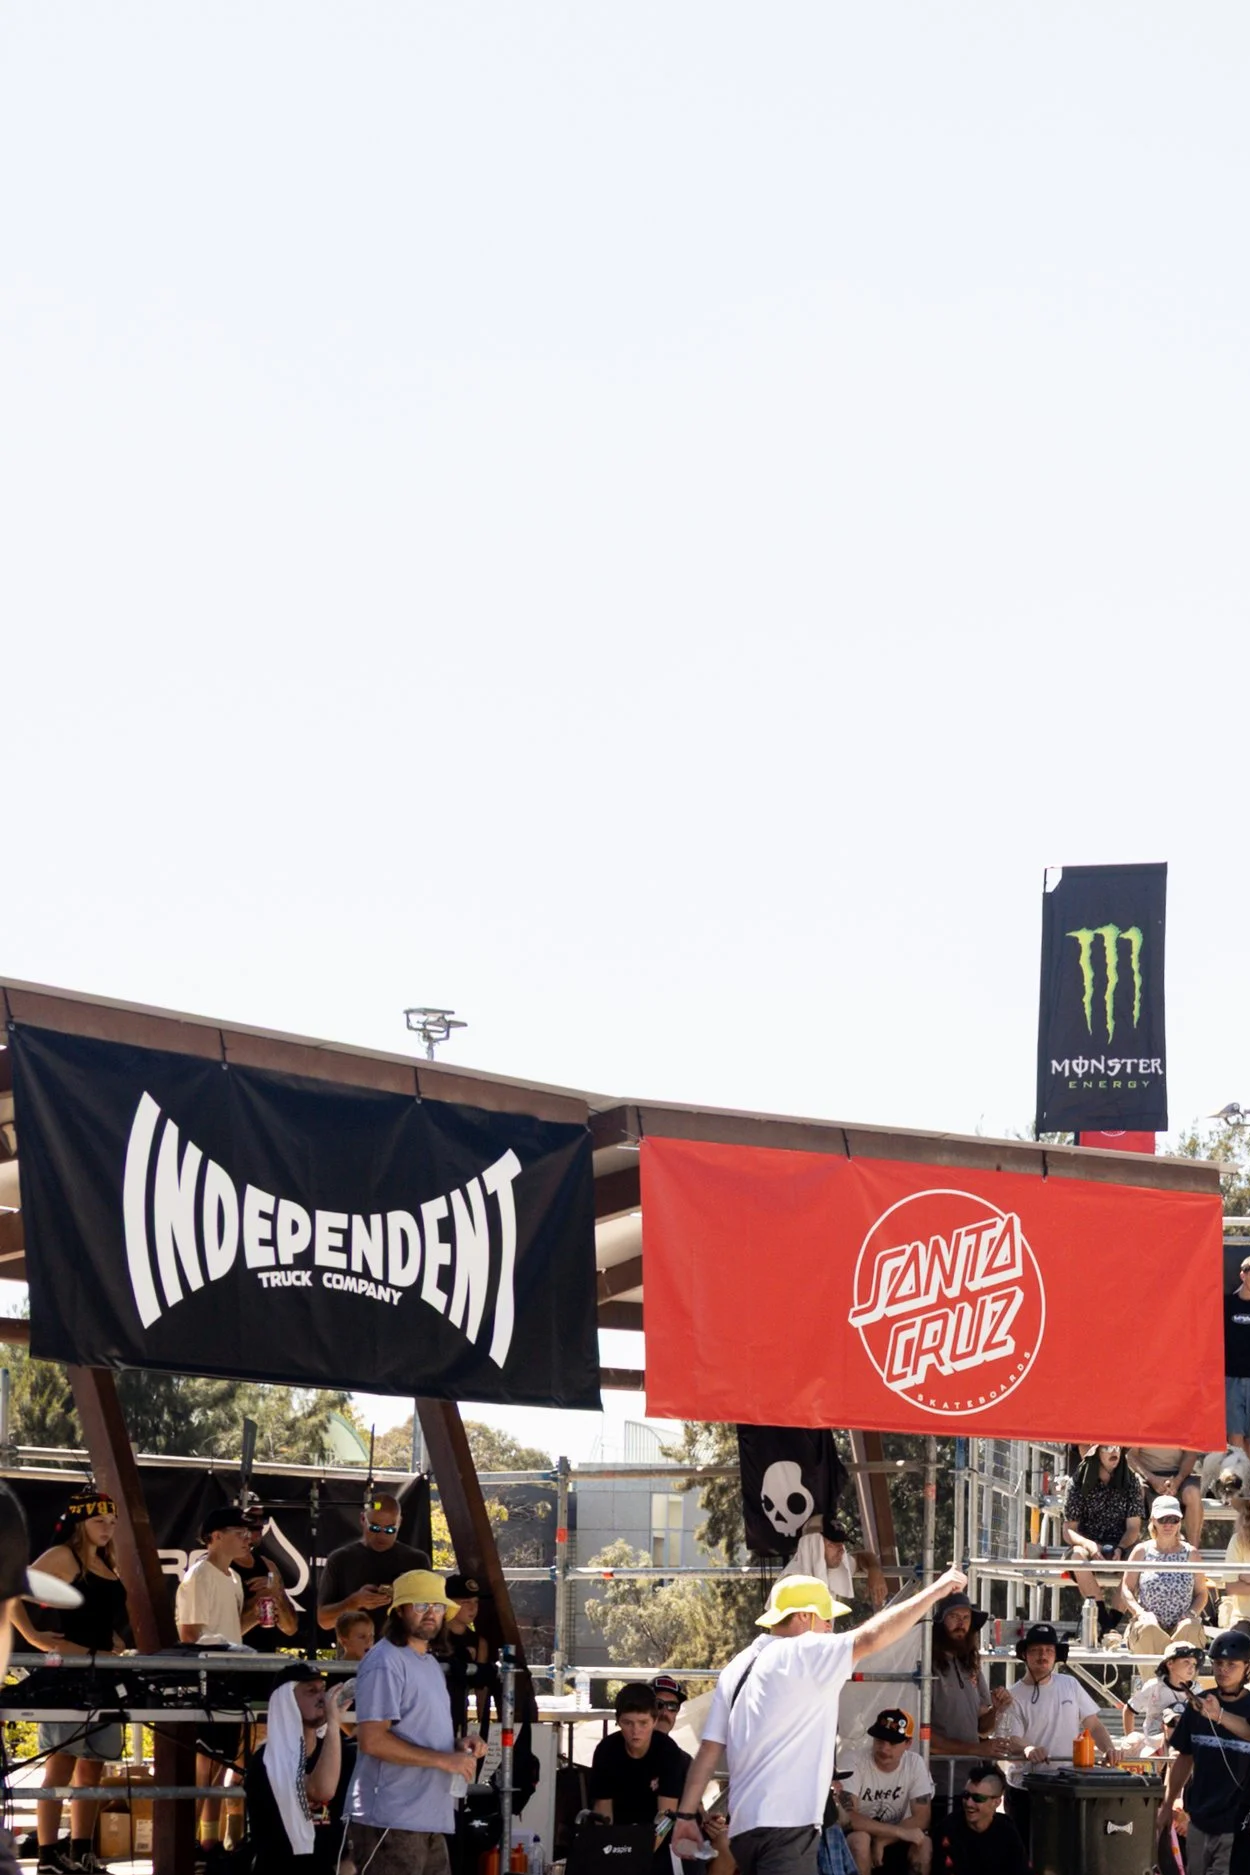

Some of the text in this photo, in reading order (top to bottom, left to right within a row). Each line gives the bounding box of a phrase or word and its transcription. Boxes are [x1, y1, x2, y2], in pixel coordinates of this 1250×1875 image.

[1050, 1054, 1164, 1079] MONSTER
[1068, 1080, 1151, 1089] ENERGY
[122, 1091, 523, 1370] INDEPENDENT
[257, 1270, 403, 1307] TRUCK COMPANY
[849, 1212, 1025, 1328] SANTA
[882, 1286, 1025, 1394] CRUZ
[917, 1349, 1033, 1412] SKATEBOARDS
[612, 1846, 632, 1854] aspire
